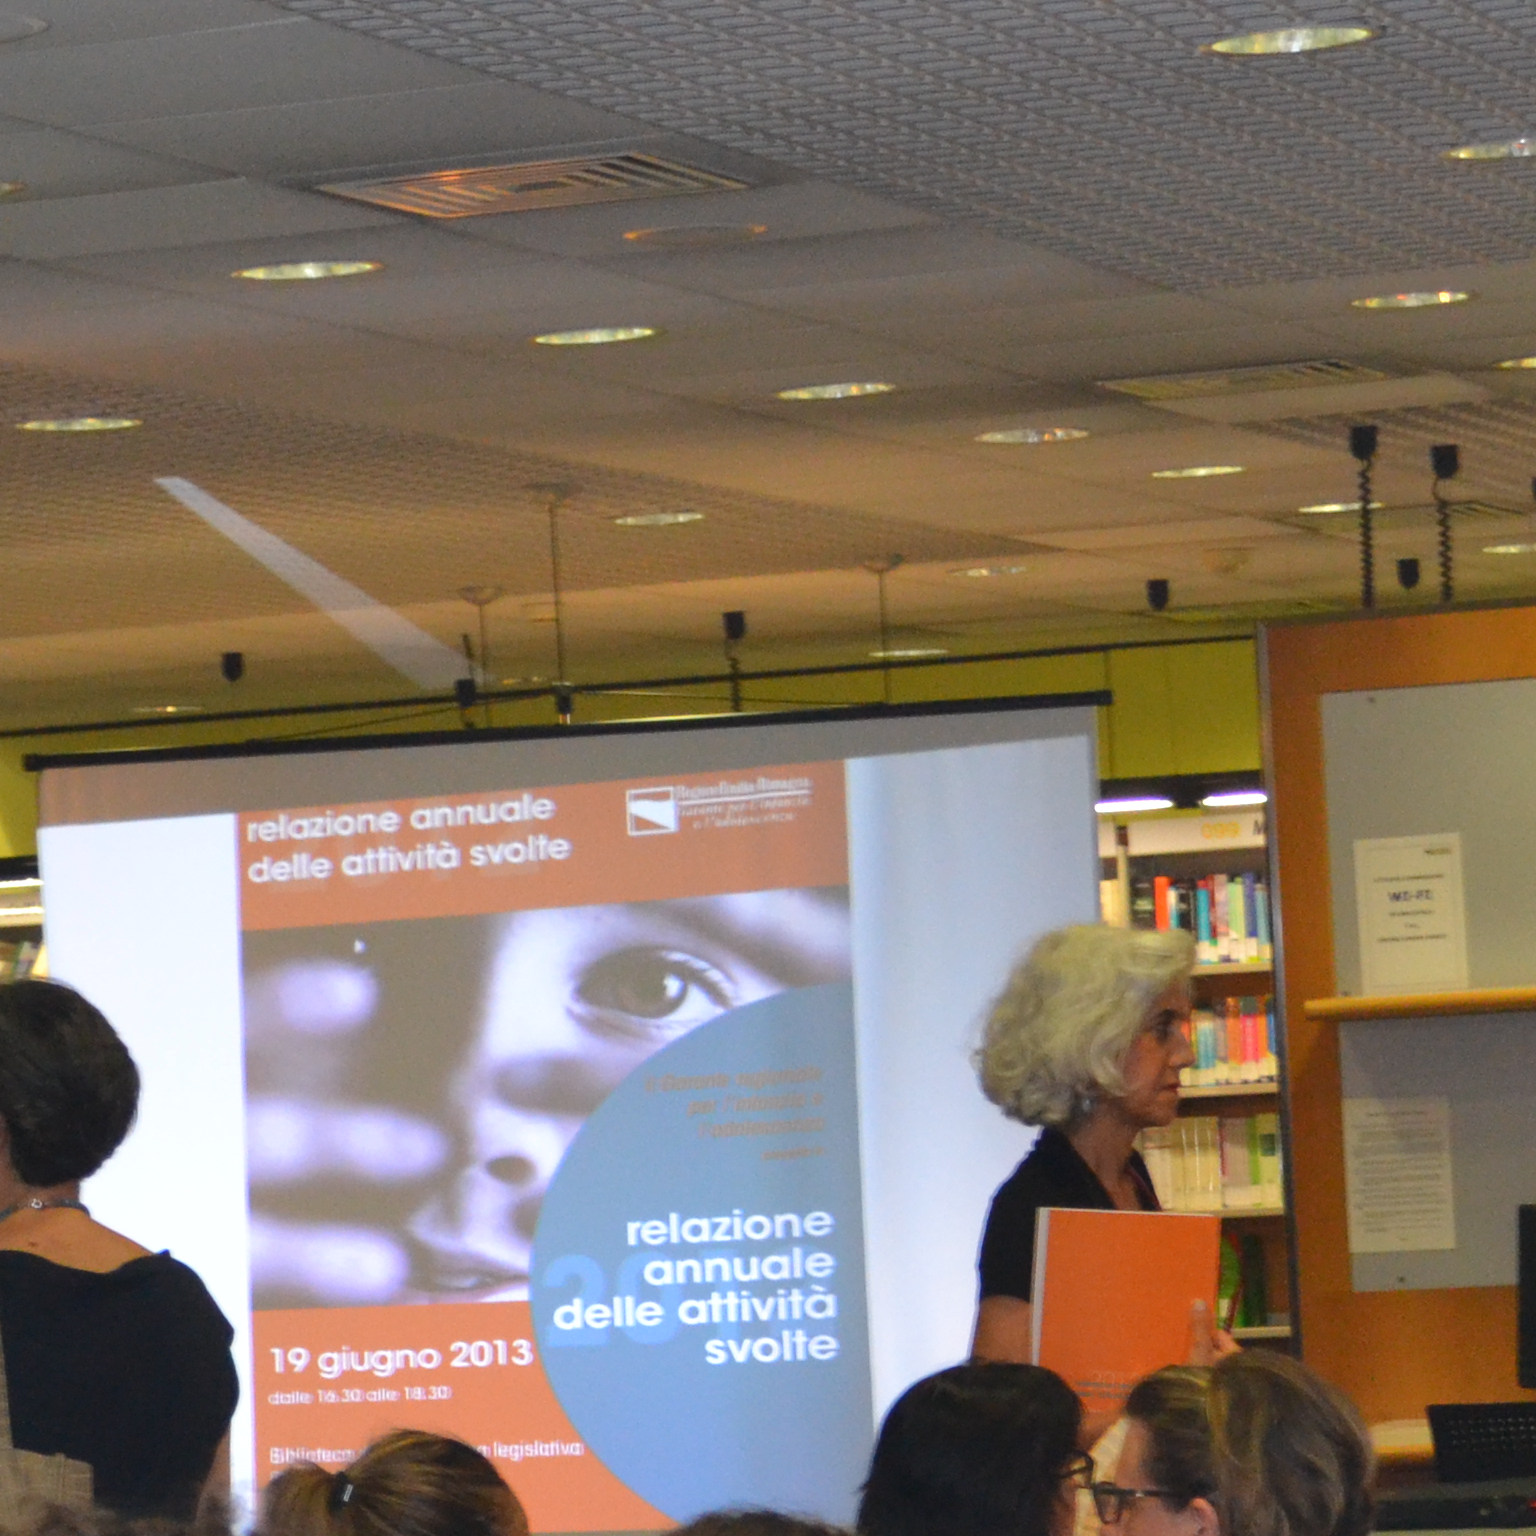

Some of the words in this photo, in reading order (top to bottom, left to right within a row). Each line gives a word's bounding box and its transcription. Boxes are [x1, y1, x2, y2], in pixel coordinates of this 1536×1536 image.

[247, 810, 402, 843] relazione
[410, 793, 557, 830] annuale
[248, 852, 333, 883] delle
[341, 840, 462, 876] attività
[469, 833, 573, 867] svolte
[626, 1209, 835, 1246] relazione
[643, 1247, 836, 1286] annuale
[553, 1297, 664, 1330] delle
[677, 1284, 838, 1325] attività
[270, 1346, 310, 1374] 19
[317, 1345, 442, 1379] giugno
[450, 1339, 534, 1368] 2013
[705, 1329, 839, 1365] svolte
[268, 1389, 313, 1405] dalle
[318, 1387, 363, 1403] 16.30
[366, 1388, 398, 1402] alle
[404, 1385, 452, 1401] 18.30
[270, 1446, 357, 1465] Biblioteca
[493, 1440, 585, 1462] legislativa
